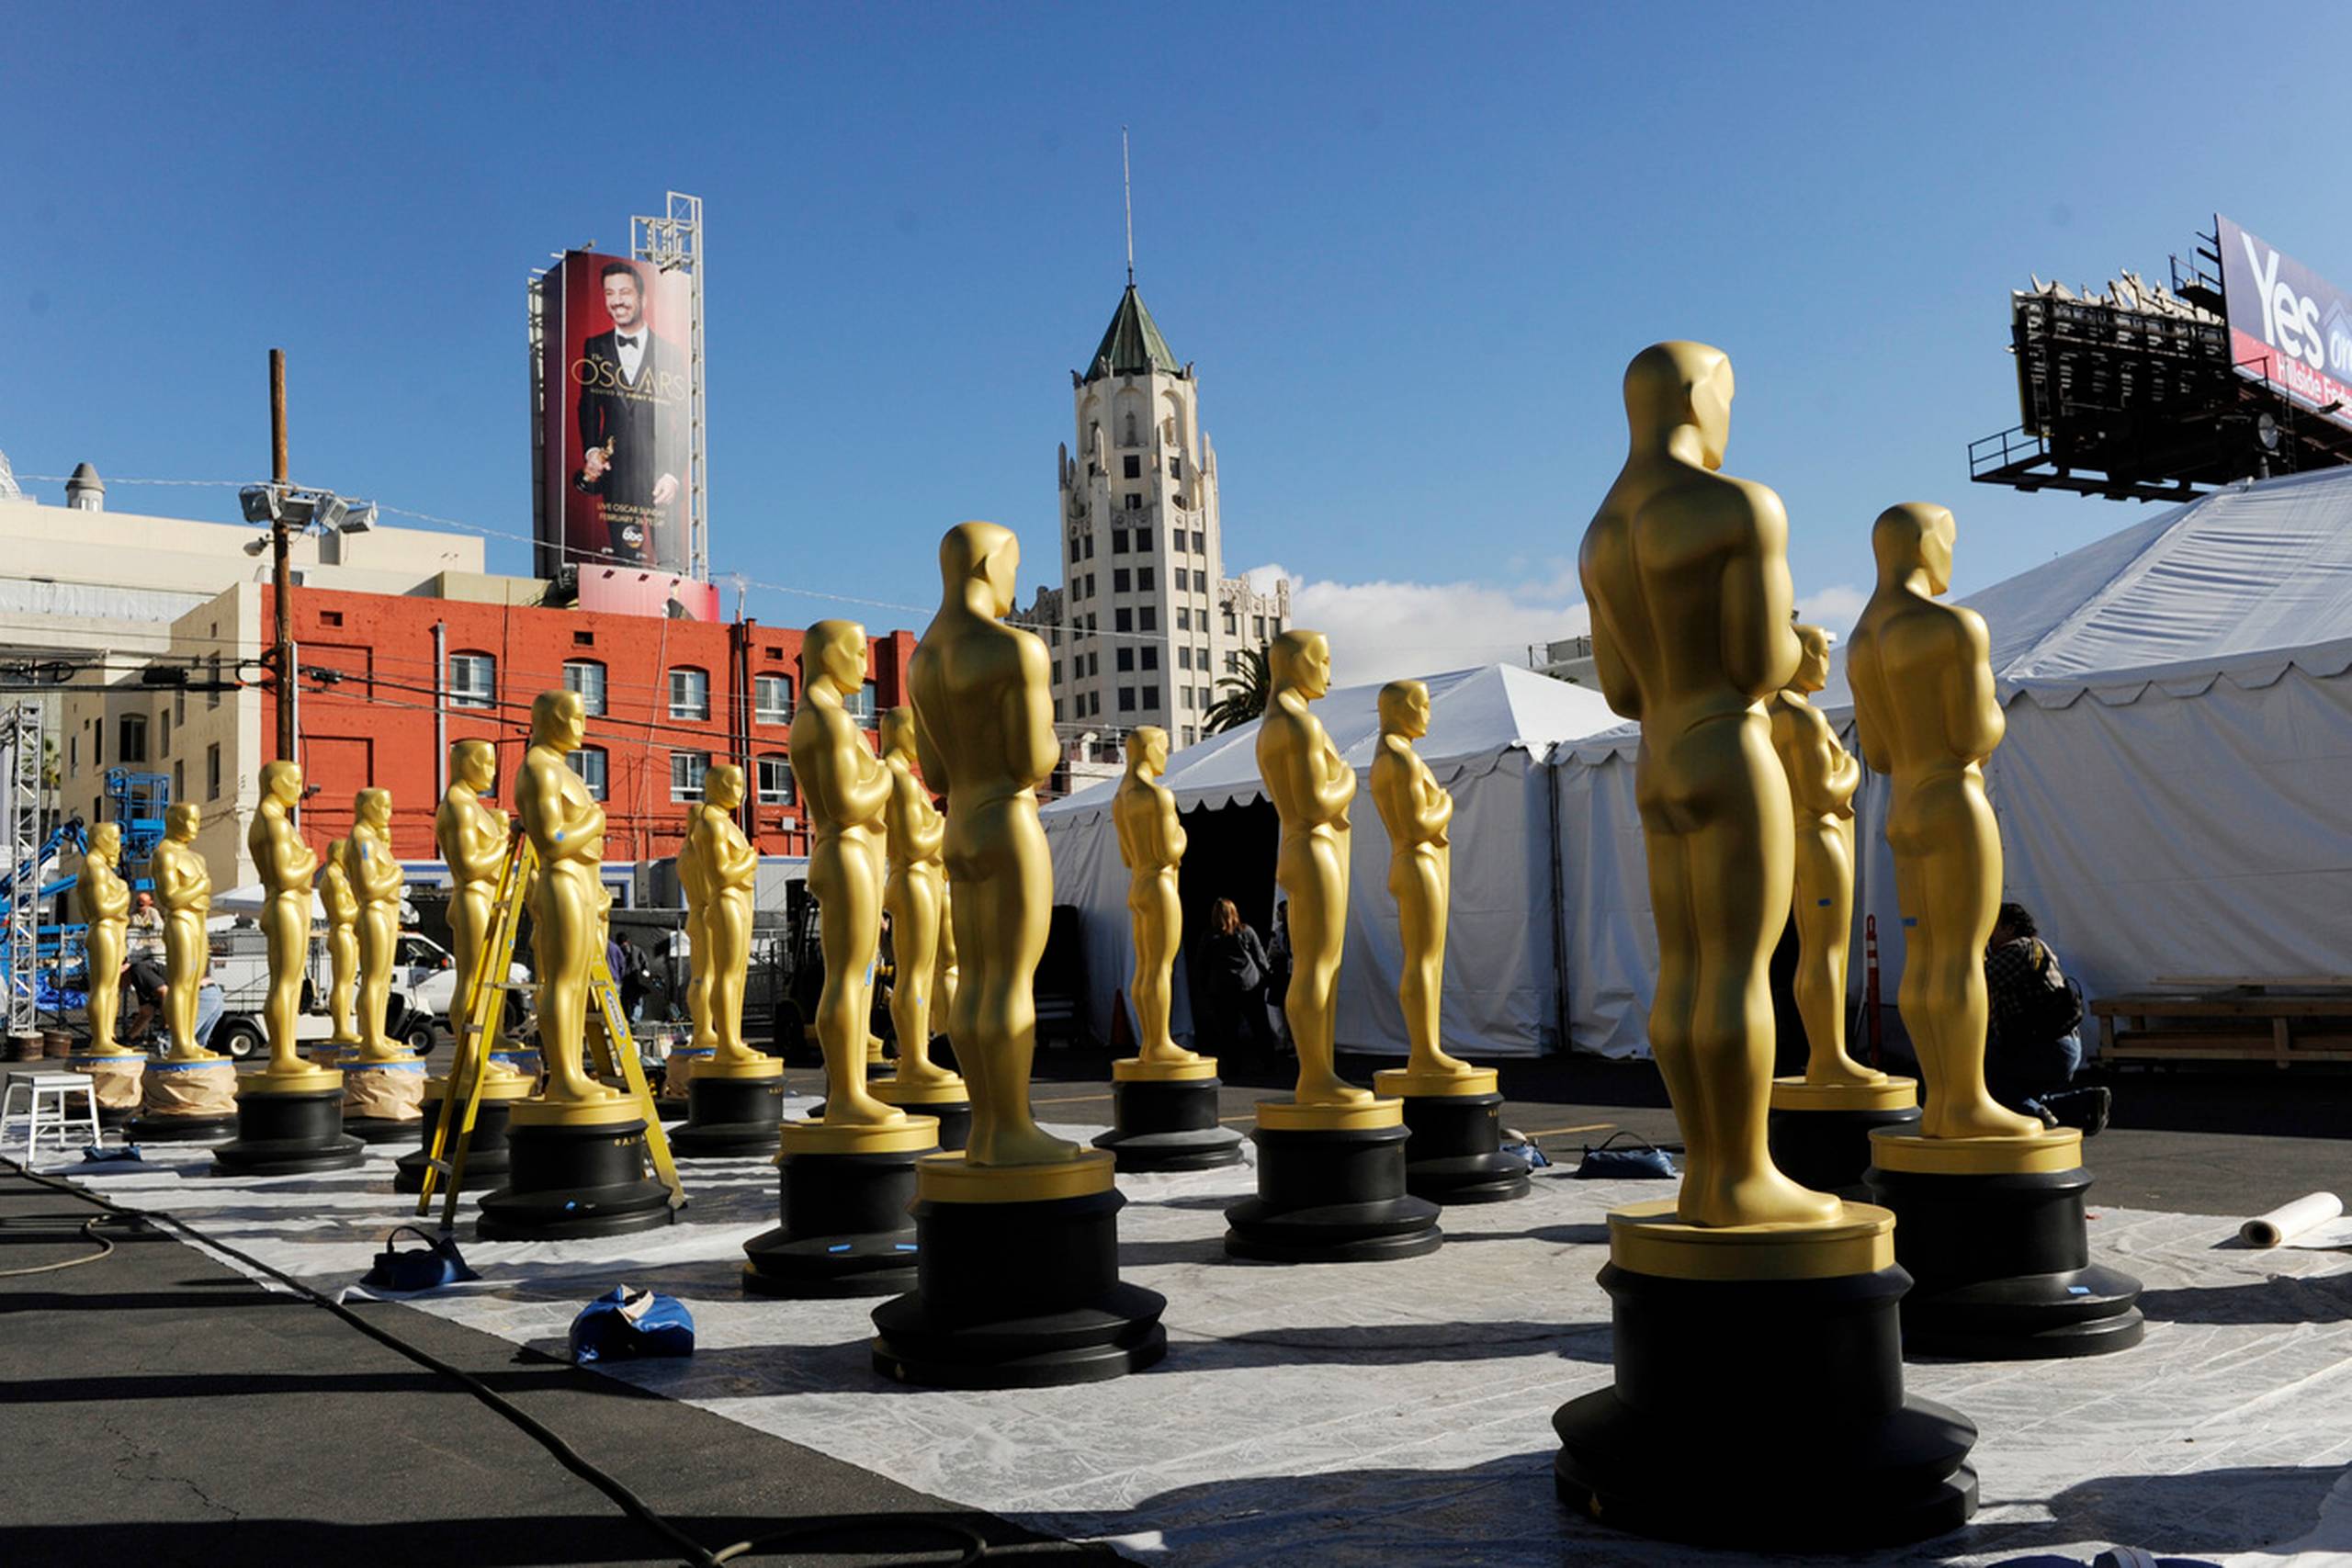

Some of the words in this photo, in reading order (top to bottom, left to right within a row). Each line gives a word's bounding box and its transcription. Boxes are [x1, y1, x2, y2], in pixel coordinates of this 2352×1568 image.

[2241, 231, 2324, 370] Yes
[571, 358, 685, 400] OSCARS
[613, 502, 638, 513] OSCAR
